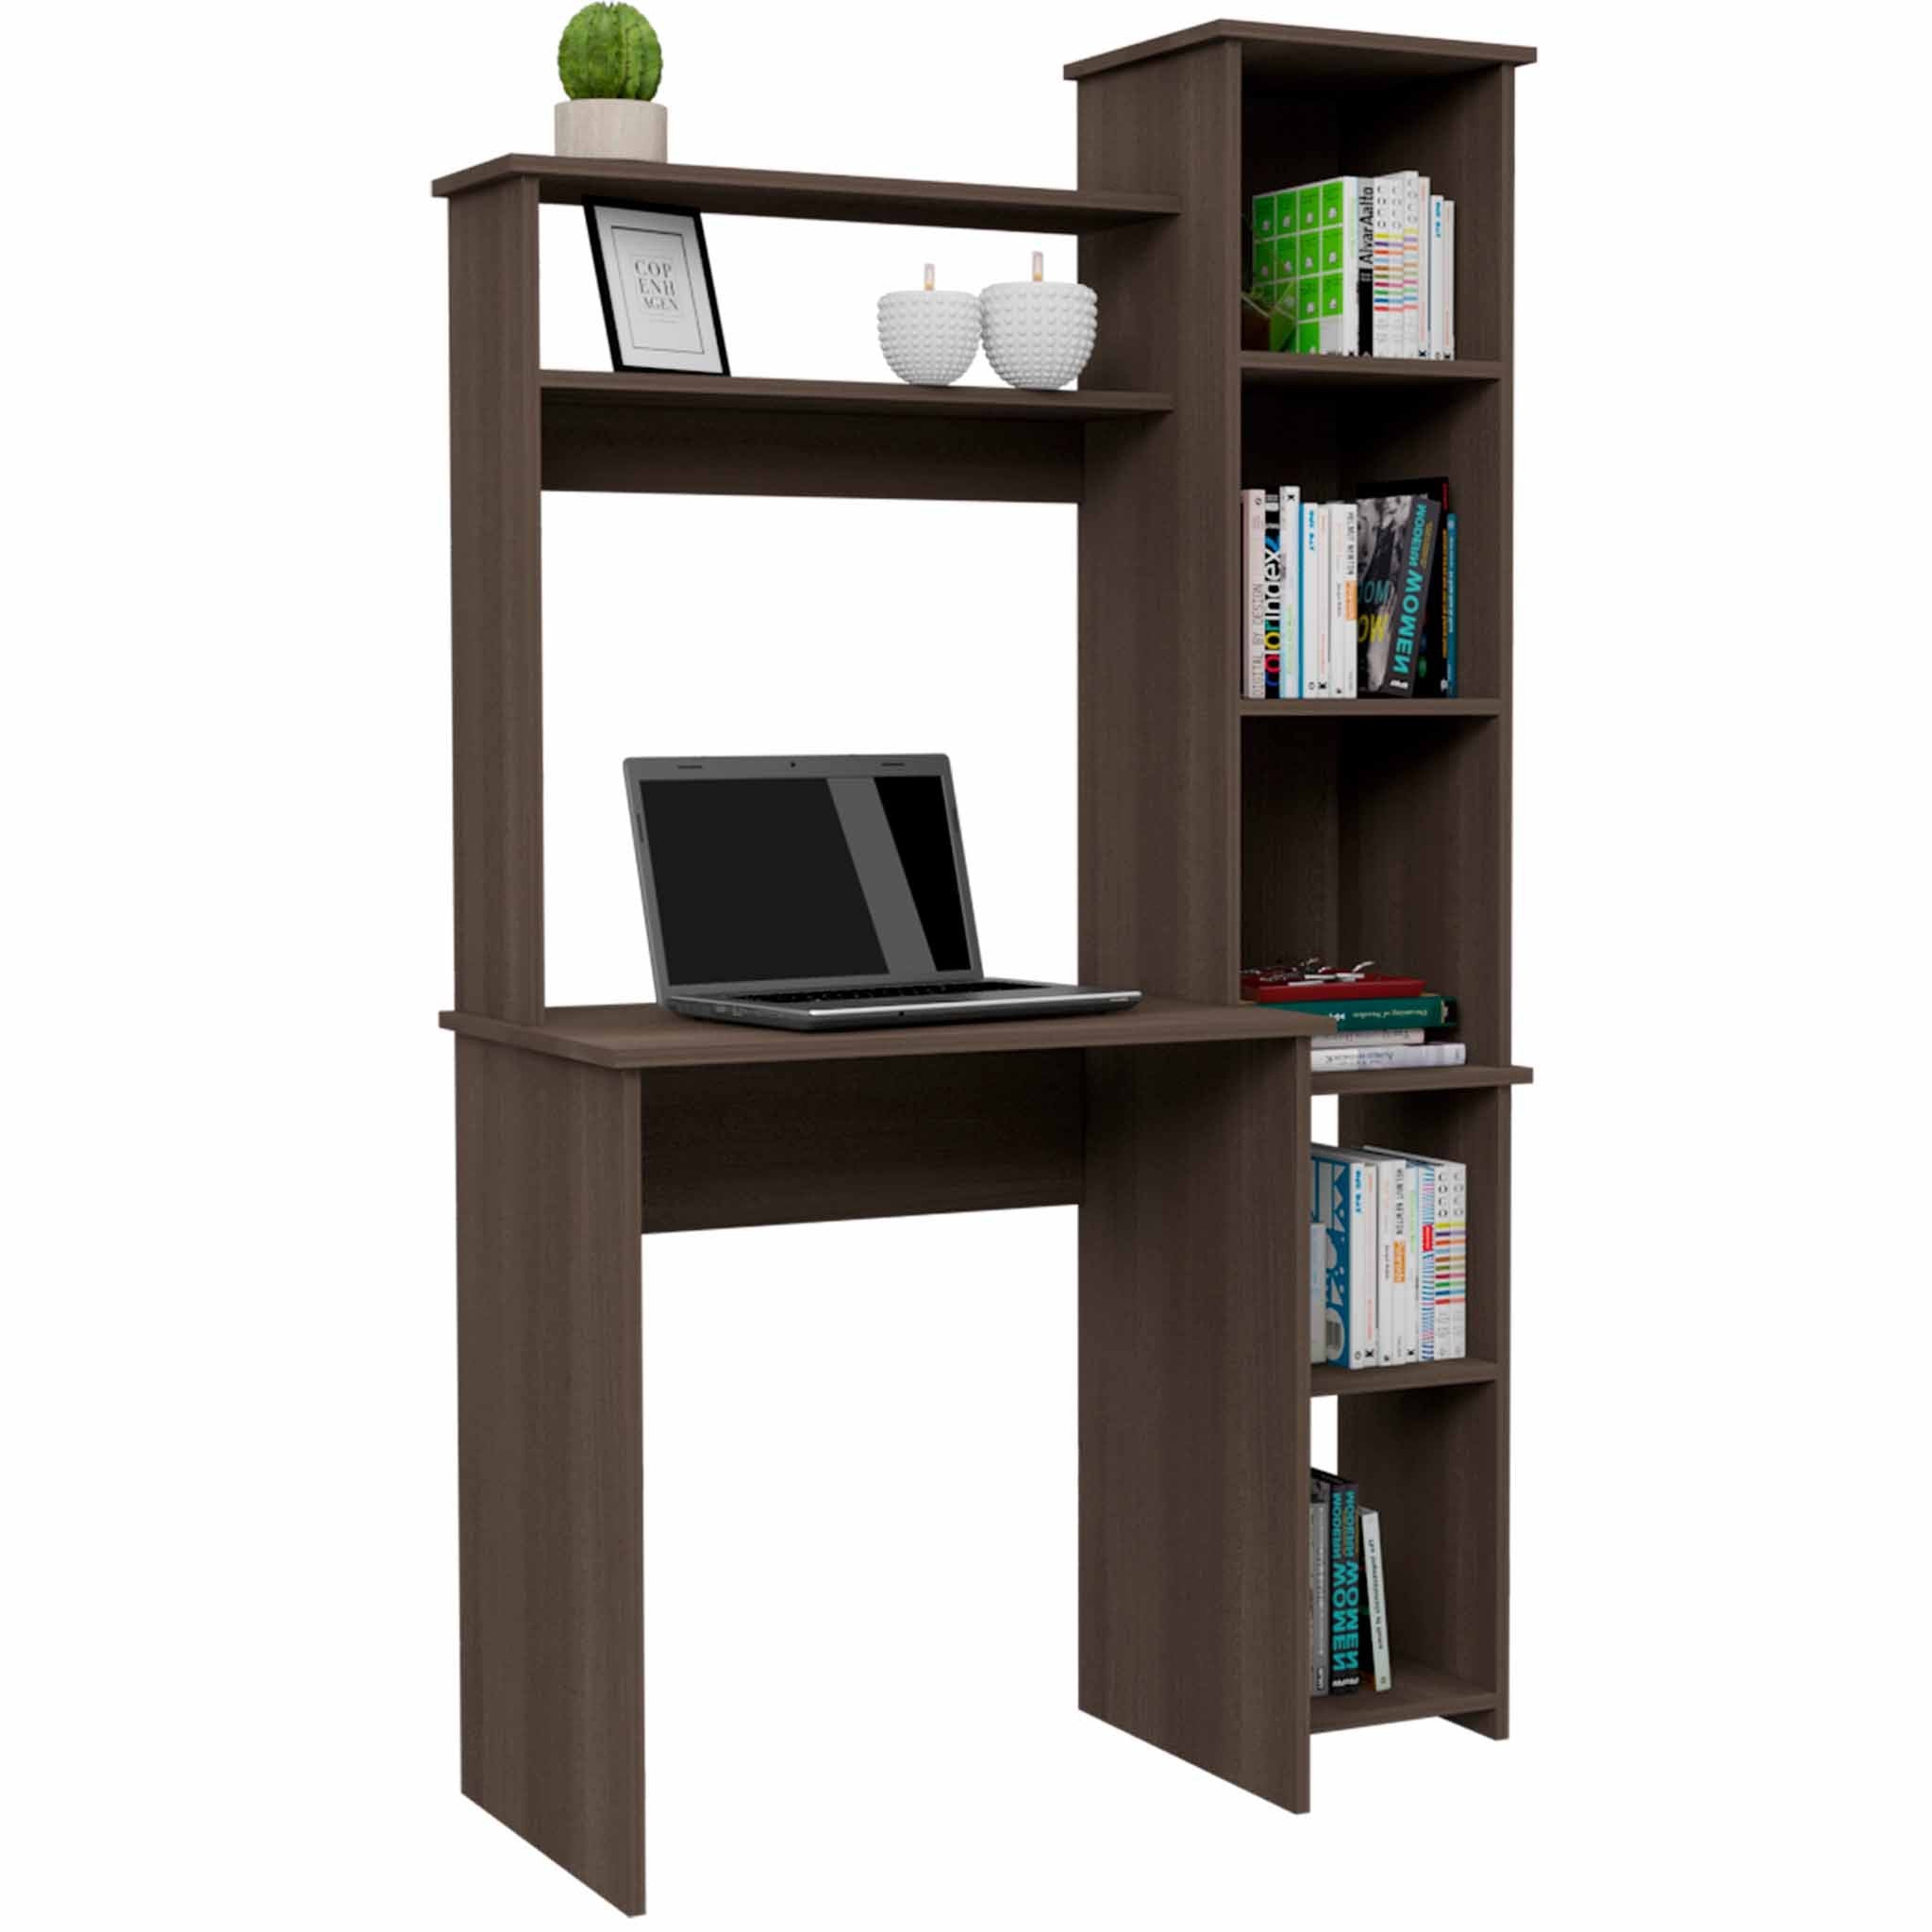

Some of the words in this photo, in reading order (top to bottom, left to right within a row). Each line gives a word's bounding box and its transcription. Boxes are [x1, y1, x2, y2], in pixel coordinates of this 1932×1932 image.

[1358, 187, 1374, 226] Aalto
[1358, 227, 1374, 264] Alvar
[634, 258, 673, 278] COP
[639, 277, 676, 296] ENH
